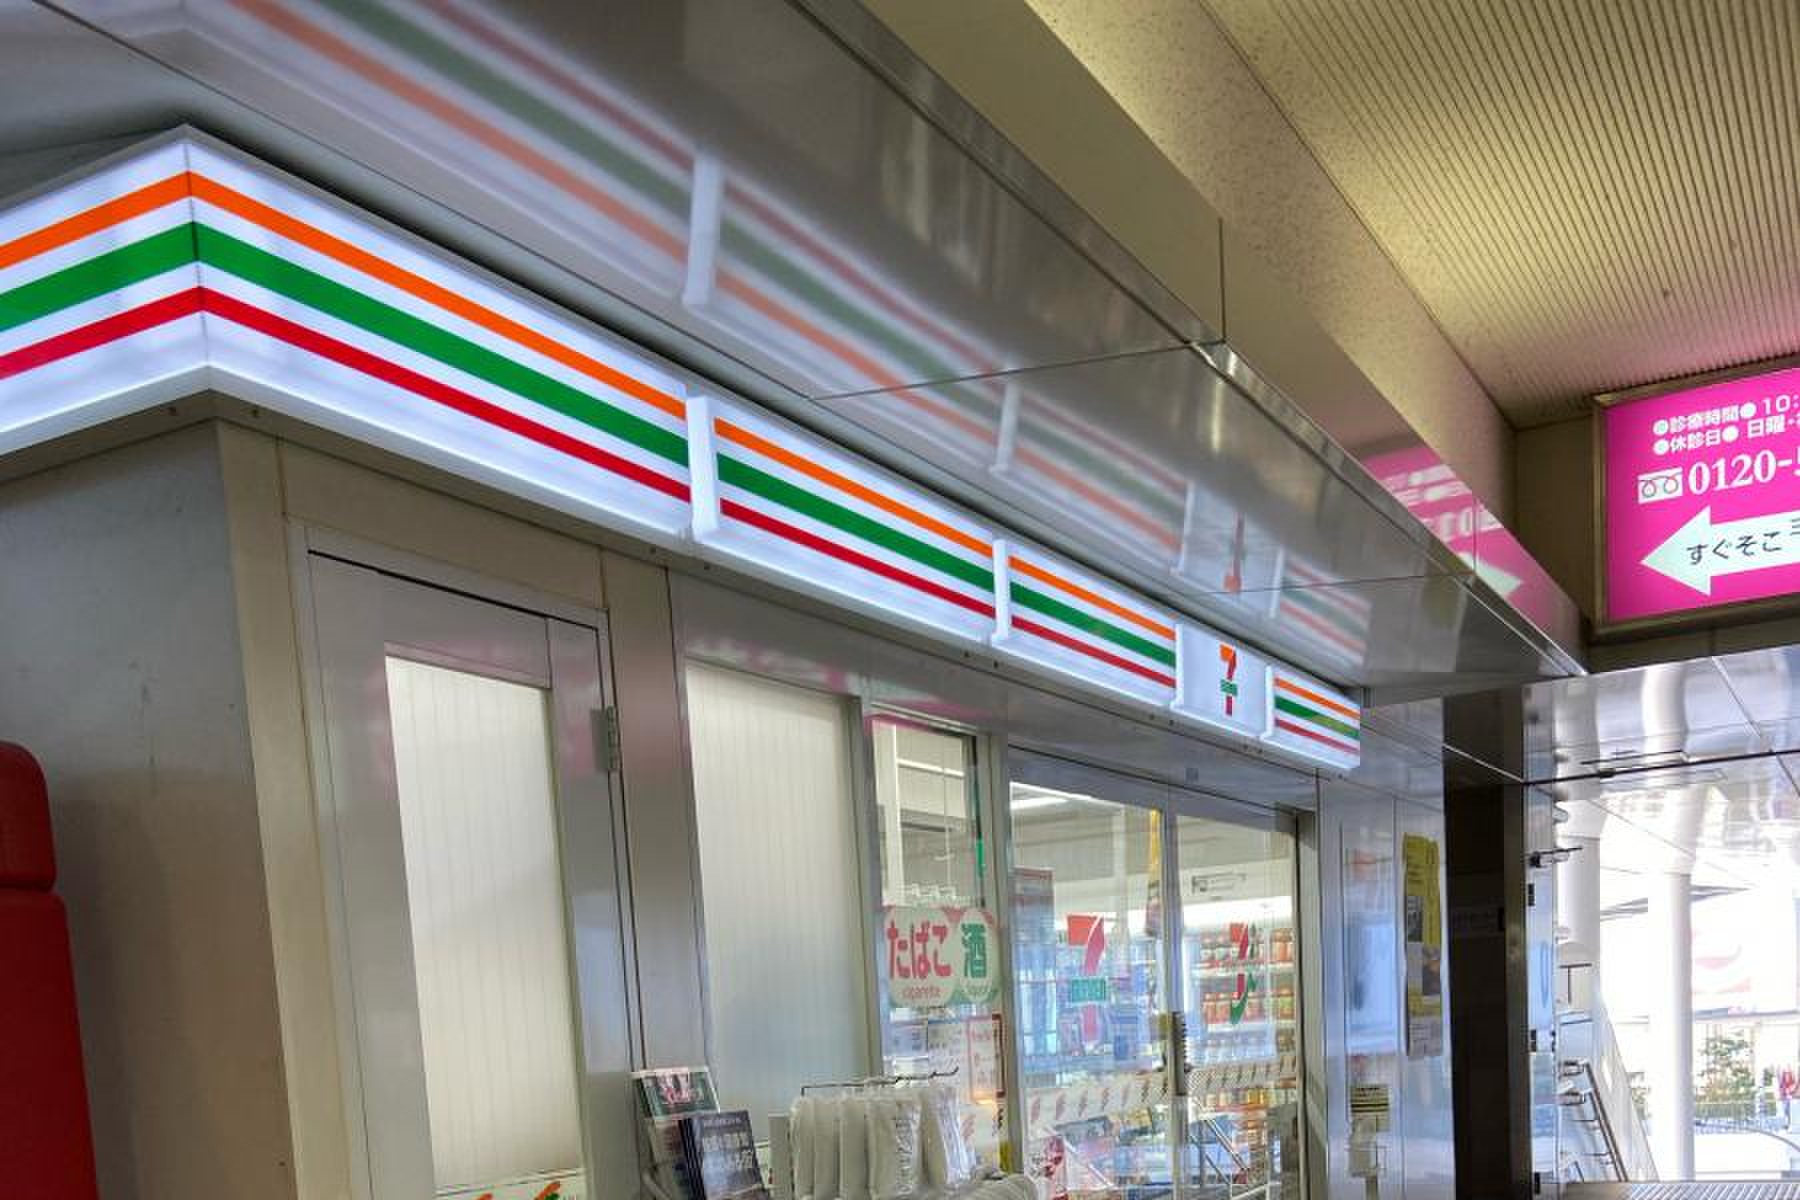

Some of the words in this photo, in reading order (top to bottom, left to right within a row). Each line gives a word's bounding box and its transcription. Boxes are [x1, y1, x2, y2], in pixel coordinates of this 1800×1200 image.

[1688, 447, 1800, 495] 0120-
[887, 921, 951, 979] たばこ
[961, 922, 987, 979] 酒
